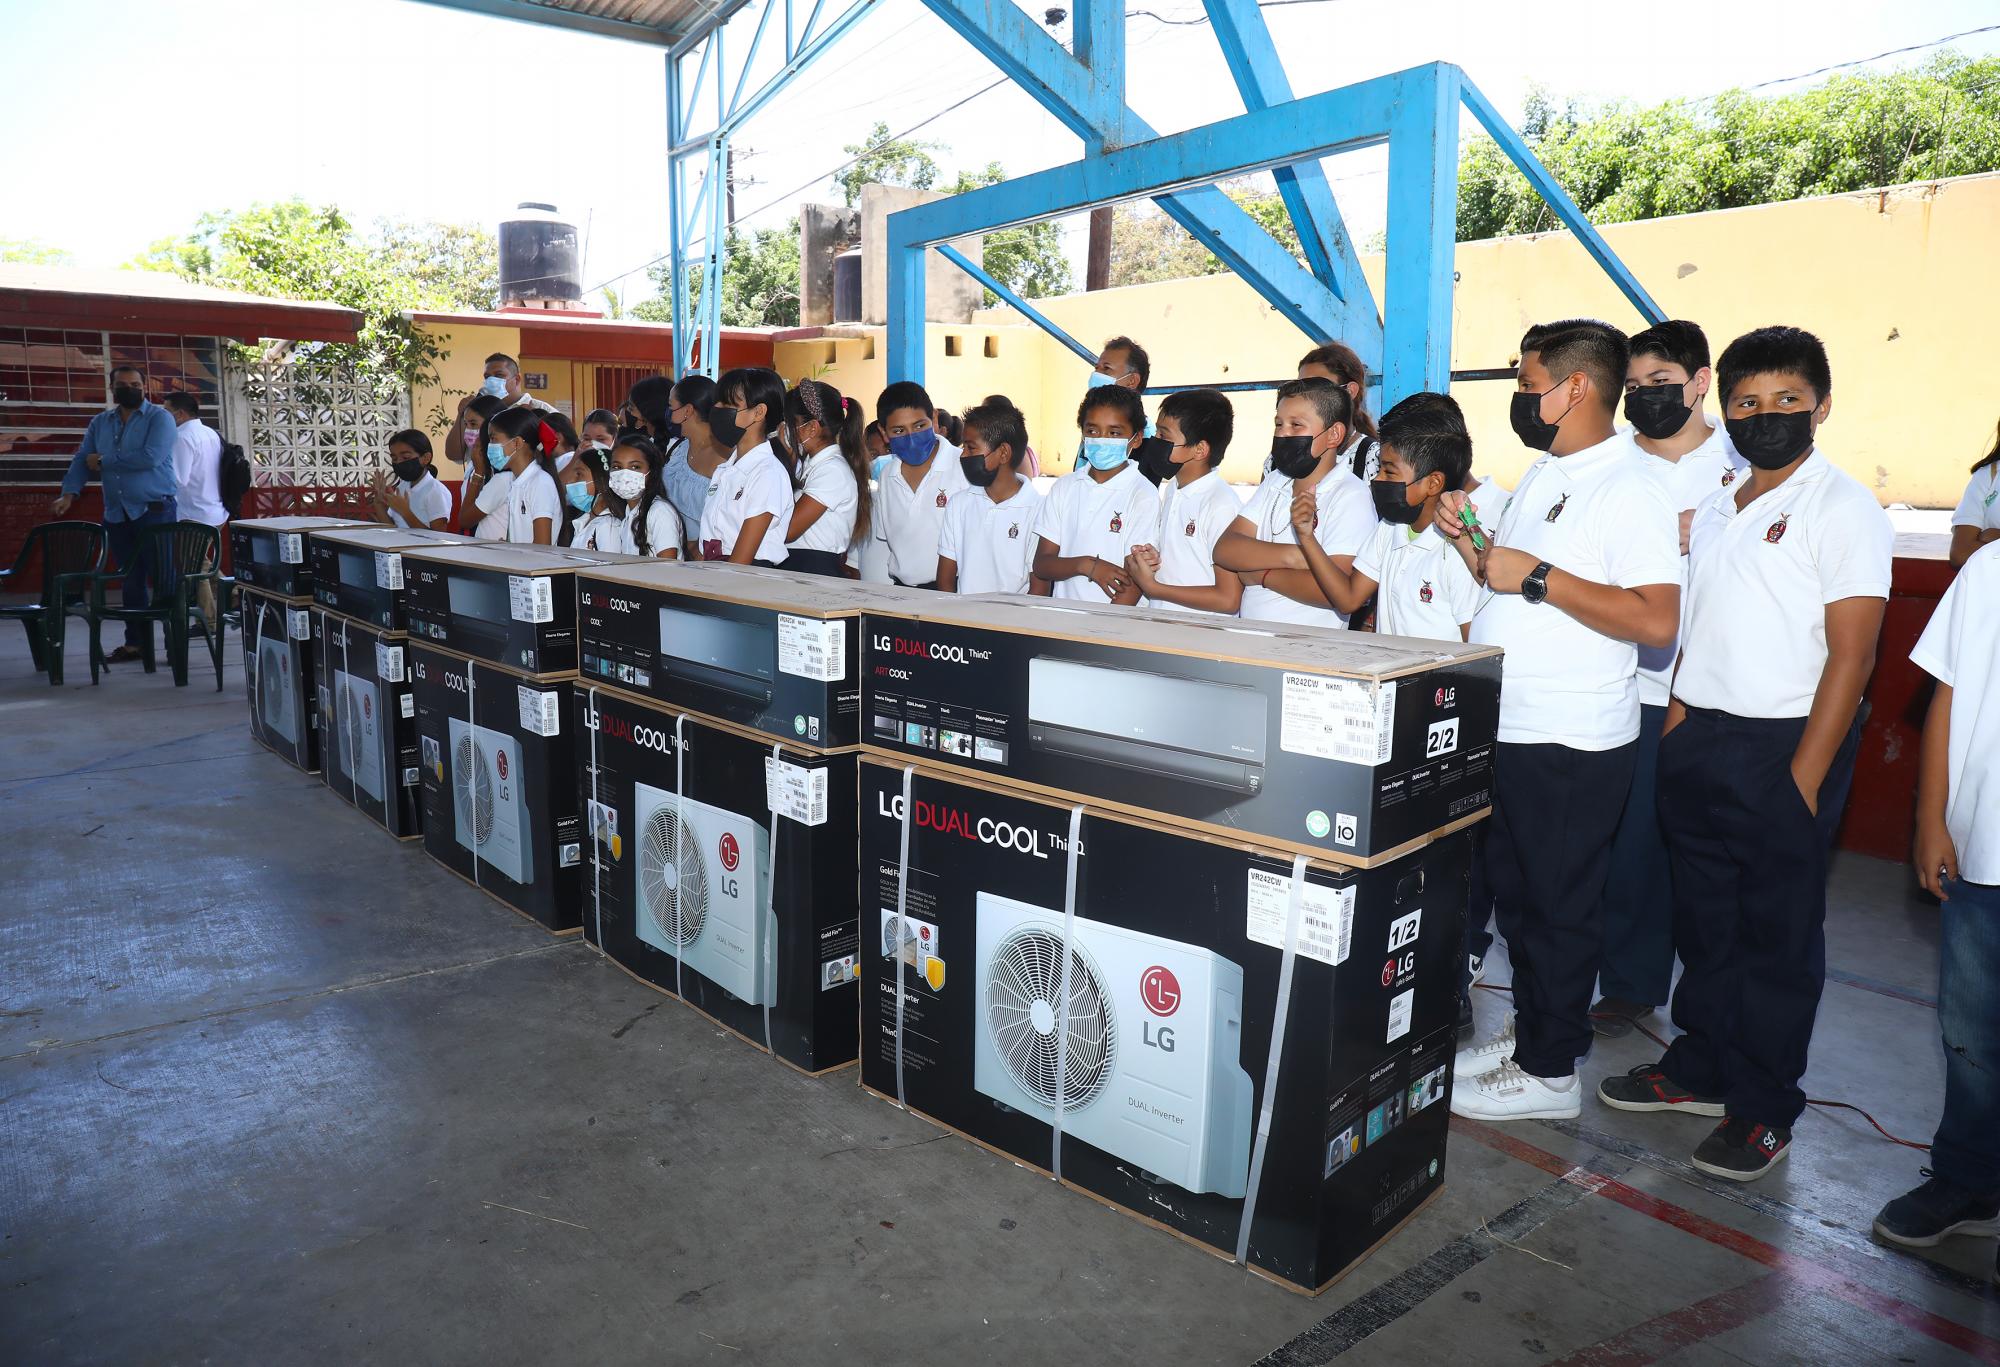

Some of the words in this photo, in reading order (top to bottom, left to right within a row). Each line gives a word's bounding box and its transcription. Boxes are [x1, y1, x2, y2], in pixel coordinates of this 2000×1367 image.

[582, 592, 591, 605] LG
[874, 634, 891, 652] LG
[416, 661, 426, 679] LG
[1286, 676, 1319, 689] VR242CW
[1445, 687, 1455, 702] LG
[584, 708, 600, 731] LG
[1428, 727, 1455, 754] 2/2
[500, 784, 509, 802] LG
[915, 800, 1048, 859] DUALCOOL
[1048, 833, 1086, 856] ThiQ
[880, 866, 893, 876] Gold
[1250, 872, 1282, 887] VR242CW
[722, 876, 738, 899] LG
[1391, 919, 1417, 946] 1/2
[920, 941, 930, 952] LG
[1397, 952, 1415, 977] LG
[1143, 1020, 1175, 1053] LG
[1128, 1097, 1150, 1113] DUAL
[1152, 1106, 1185, 1126] Inverter
